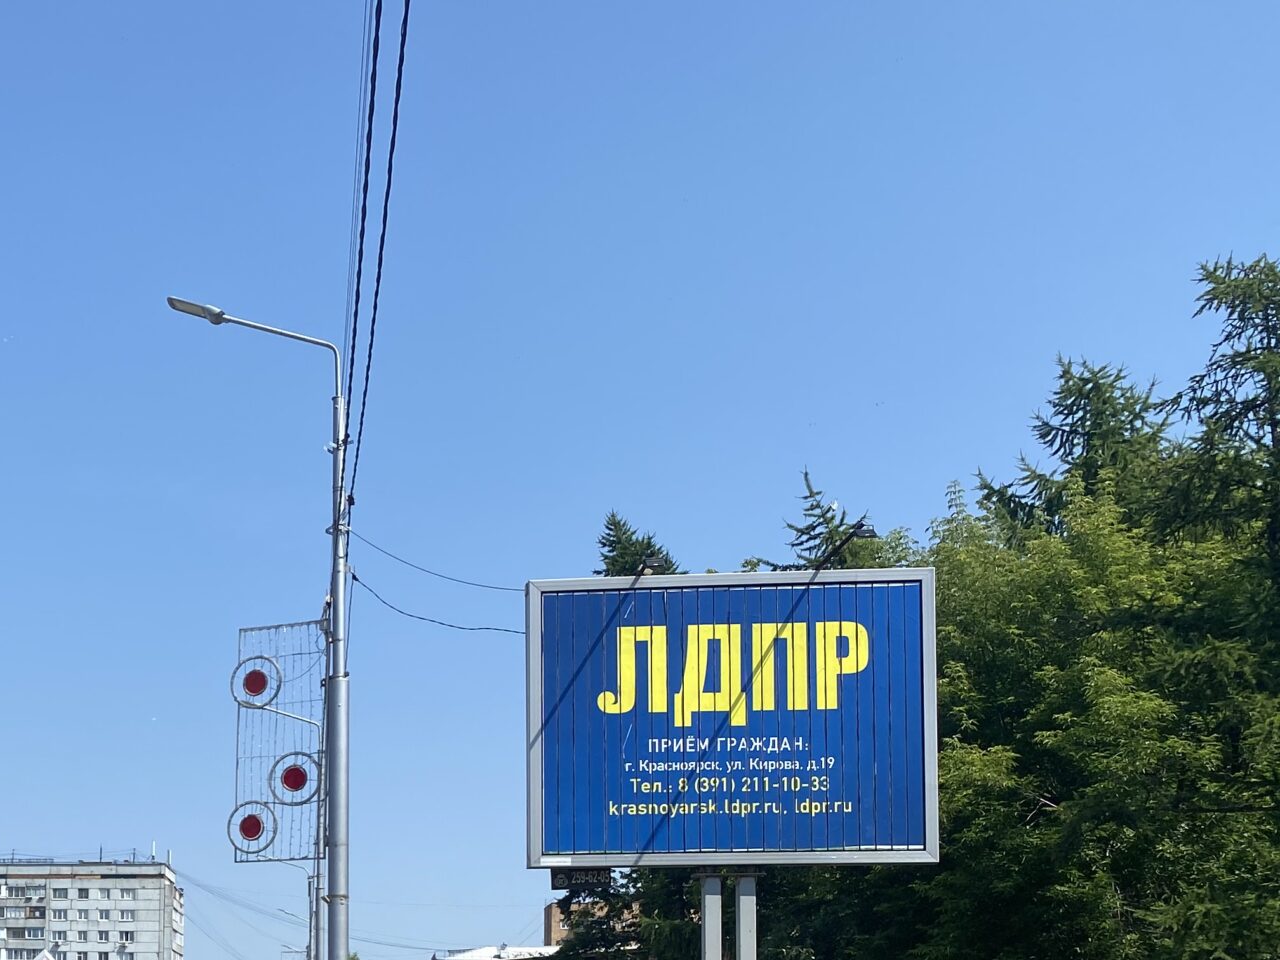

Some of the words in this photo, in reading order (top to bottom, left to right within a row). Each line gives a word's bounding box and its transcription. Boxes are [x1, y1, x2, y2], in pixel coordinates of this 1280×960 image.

[597, 621, 869, 727] ЛДПР
[648, 736, 709, 753] ПРИЁМ
[717, 736, 809, 754] ГРАЖДАН:
[625, 762, 635, 772] г.
[726, 760, 745, 774] ул.
[806, 756, 835, 772] д.19
[630, 778, 673, 793] Тел.:
[678, 778, 689, 792] 8
[694, 777, 736, 793] (391)
[741, 776, 830, 792] 211-10-33
[795, 798, 852, 817] ldpr.ru
[571, 869, 611, 884] 259-62-05
